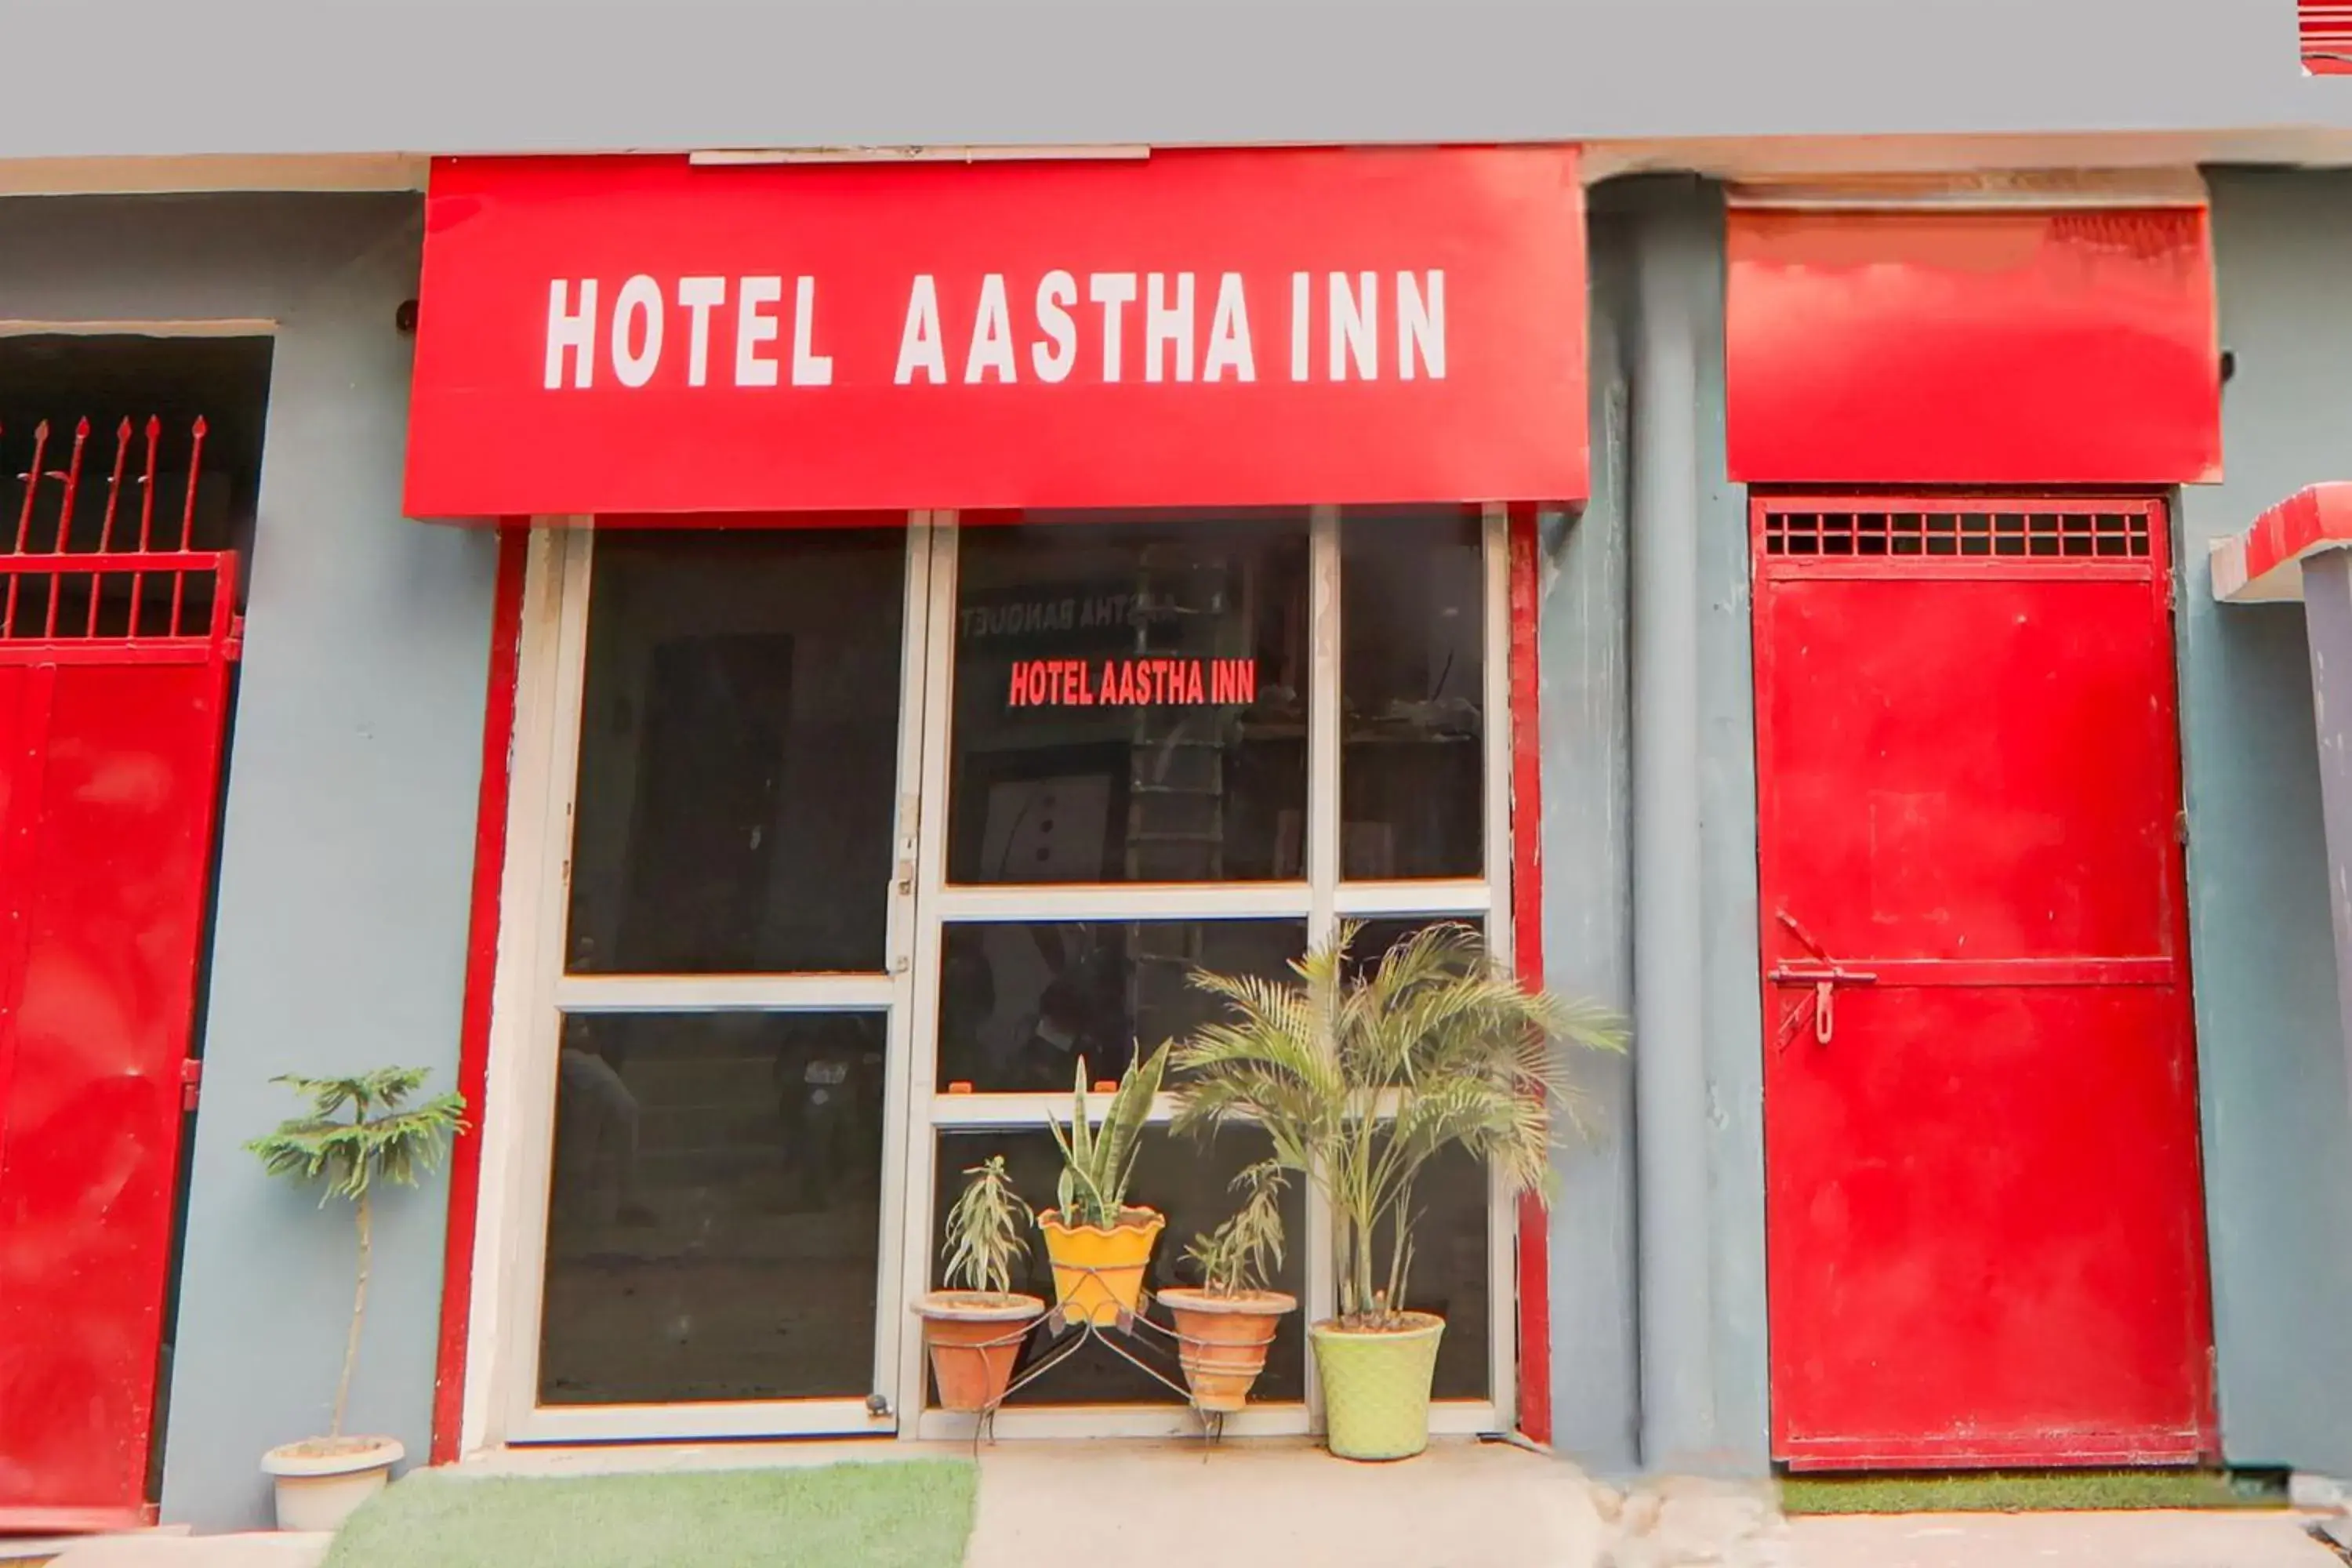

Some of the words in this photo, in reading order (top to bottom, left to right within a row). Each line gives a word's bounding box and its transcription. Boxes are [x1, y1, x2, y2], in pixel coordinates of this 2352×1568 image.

[544, 274, 833, 388] HOTEL
[895, 270, 1256, 384] AASTHA
[1291, 270, 1446, 381] INN
[1010, 660, 1094, 705] HOTEL
[1100, 659, 1204, 705] AASTHA
[1211, 659, 1254, 703] INN
